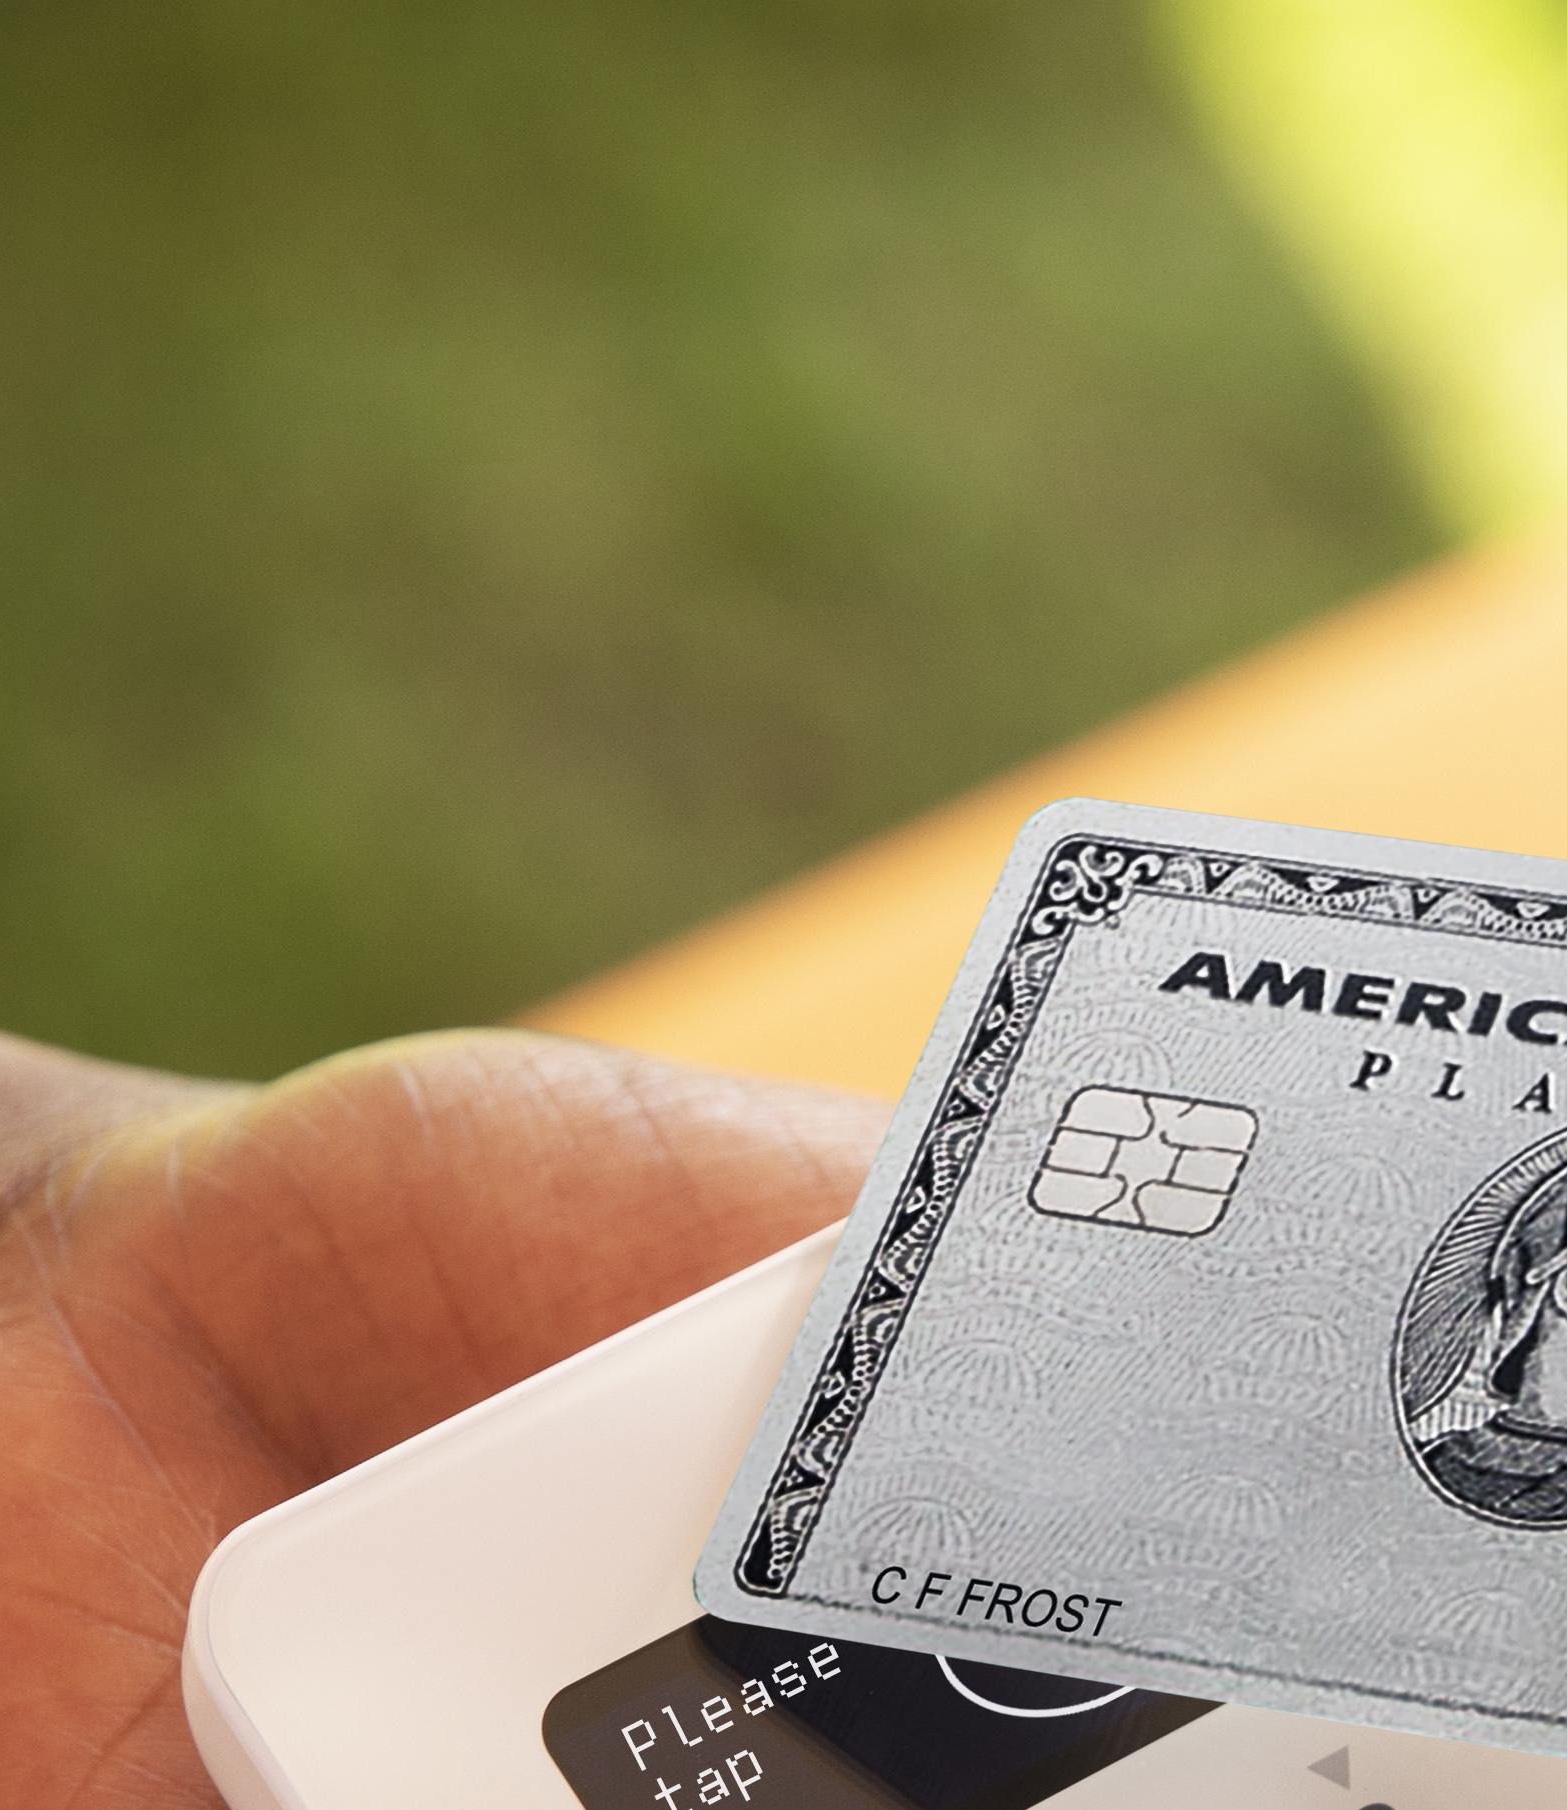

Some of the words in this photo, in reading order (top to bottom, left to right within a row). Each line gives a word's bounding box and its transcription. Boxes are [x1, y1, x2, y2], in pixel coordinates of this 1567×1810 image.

[870, 1565, 907, 1605] C
[914, 1571, 952, 1611] F
[956, 1578, 1123, 1638] FROST
[621, 1642, 842, 1771] Please
